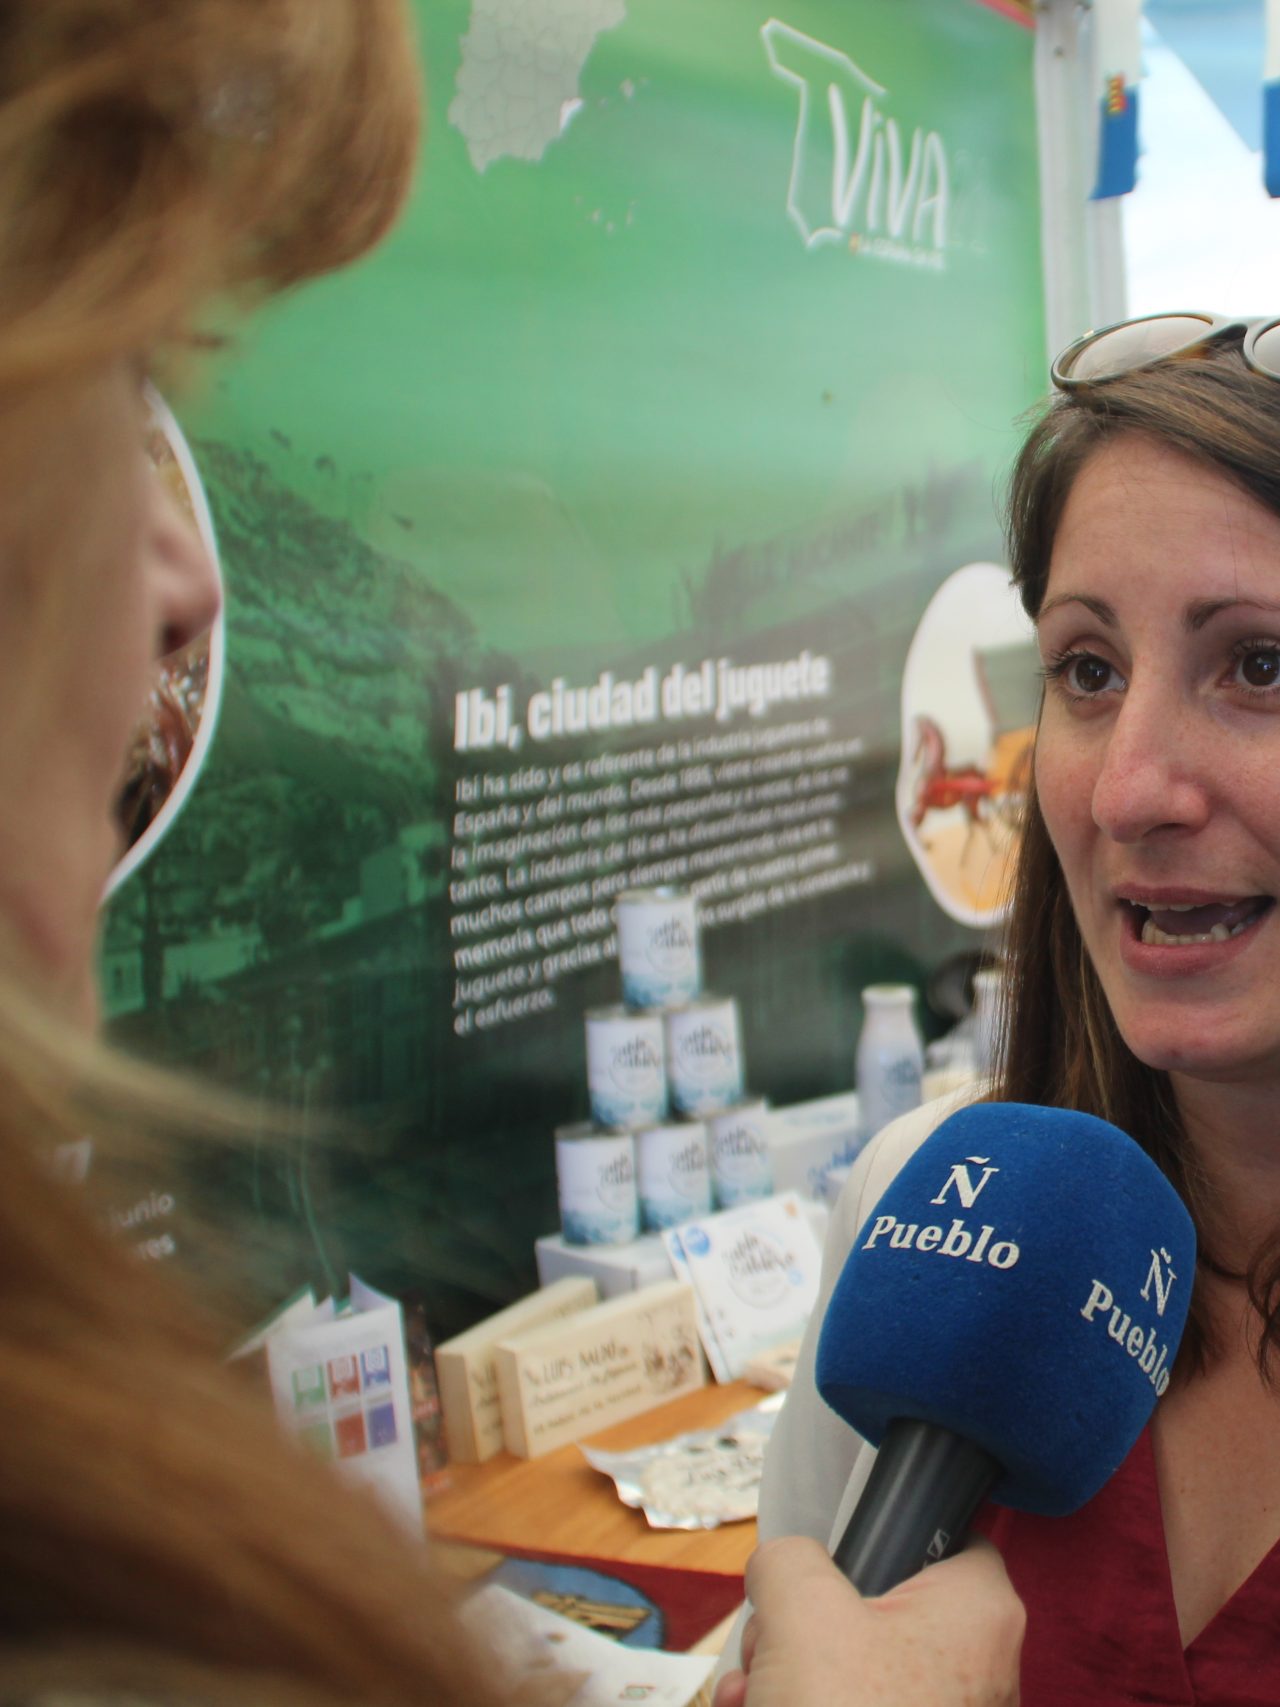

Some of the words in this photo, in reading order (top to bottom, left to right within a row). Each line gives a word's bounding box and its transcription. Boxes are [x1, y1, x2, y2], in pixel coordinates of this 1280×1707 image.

[454, 683, 522, 751] Ibi,
[527, 664, 658, 741] ciudad
[662, 660, 715, 719] del
[716, 650, 831, 722] juguete
[456, 773, 480, 804] Ibi
[483, 771, 508, 800] ha
[509, 765, 547, 796] sido
[548, 767, 561, 792] y
[562, 761, 584, 786] es
[584, 750, 655, 781] referente
[656, 744, 677, 768] de
[678, 741, 693, 762] la
[693, 730, 752, 761] industria
[450, 846, 468, 872] la
[472, 822, 581, 866] imaginación
[581, 818, 604, 843] de
[606, 811, 629, 839] los
[630, 803, 662, 830] más
[454, 803, 521, 838] España
[522, 802, 537, 828] y
[537, 793, 565, 822] del
[630, 772, 678, 802] Desde
[507, 865, 529, 891] La
[530, 847, 604, 884] industria
[604, 842, 627, 865] de
[627, 834, 649, 858] Ibi
[668, 827, 690, 848] ha
[450, 898, 525, 937] muchos
[525, 881, 592, 917] campos
[592, 870, 629, 902] pero
[629, 857, 689, 886] siempre
[454, 927, 536, 971] memoria
[536, 919, 570, 951] que
[571, 906, 609, 937] todo
[729, 866, 748, 890] de
[452, 962, 529, 1010] juguete
[527, 960, 541, 985] y
[543, 942, 603, 983] gracias
[453, 1006, 474, 1038] el
[930, 1155, 999, 1209] Ñ
[862, 1215, 1020, 1270] Pueblo
[1140, 1246, 1177, 1317] Ñ
[1080, 1279, 1170, 1397] Pueblo
